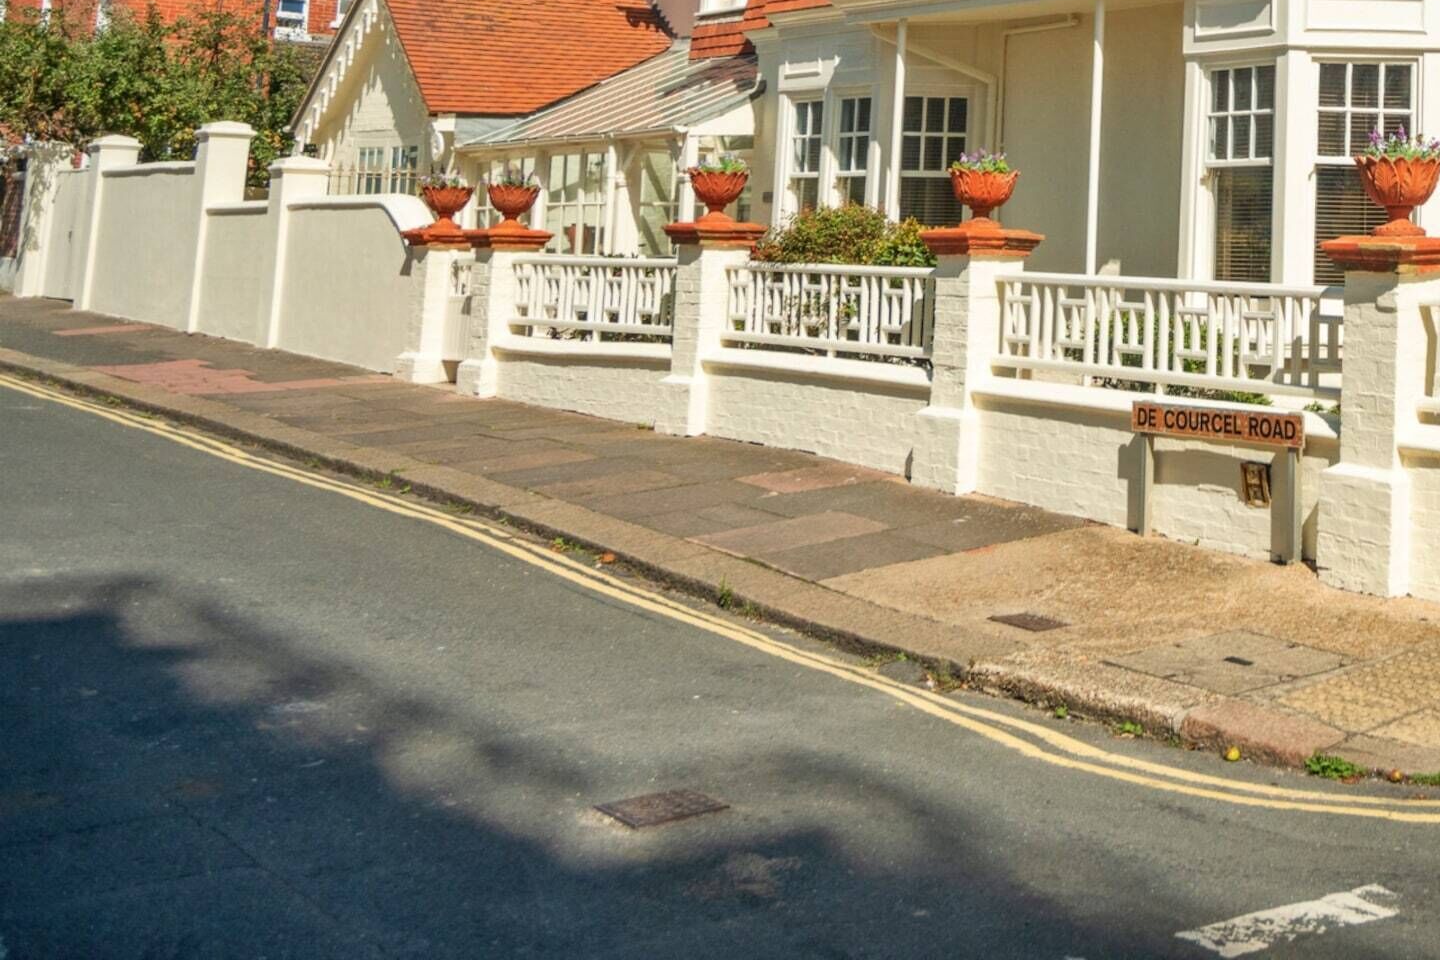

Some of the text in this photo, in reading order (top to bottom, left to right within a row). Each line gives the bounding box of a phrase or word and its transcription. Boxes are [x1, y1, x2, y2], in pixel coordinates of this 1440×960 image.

[1137, 407, 1296, 440] DE COURCEL ROAD
